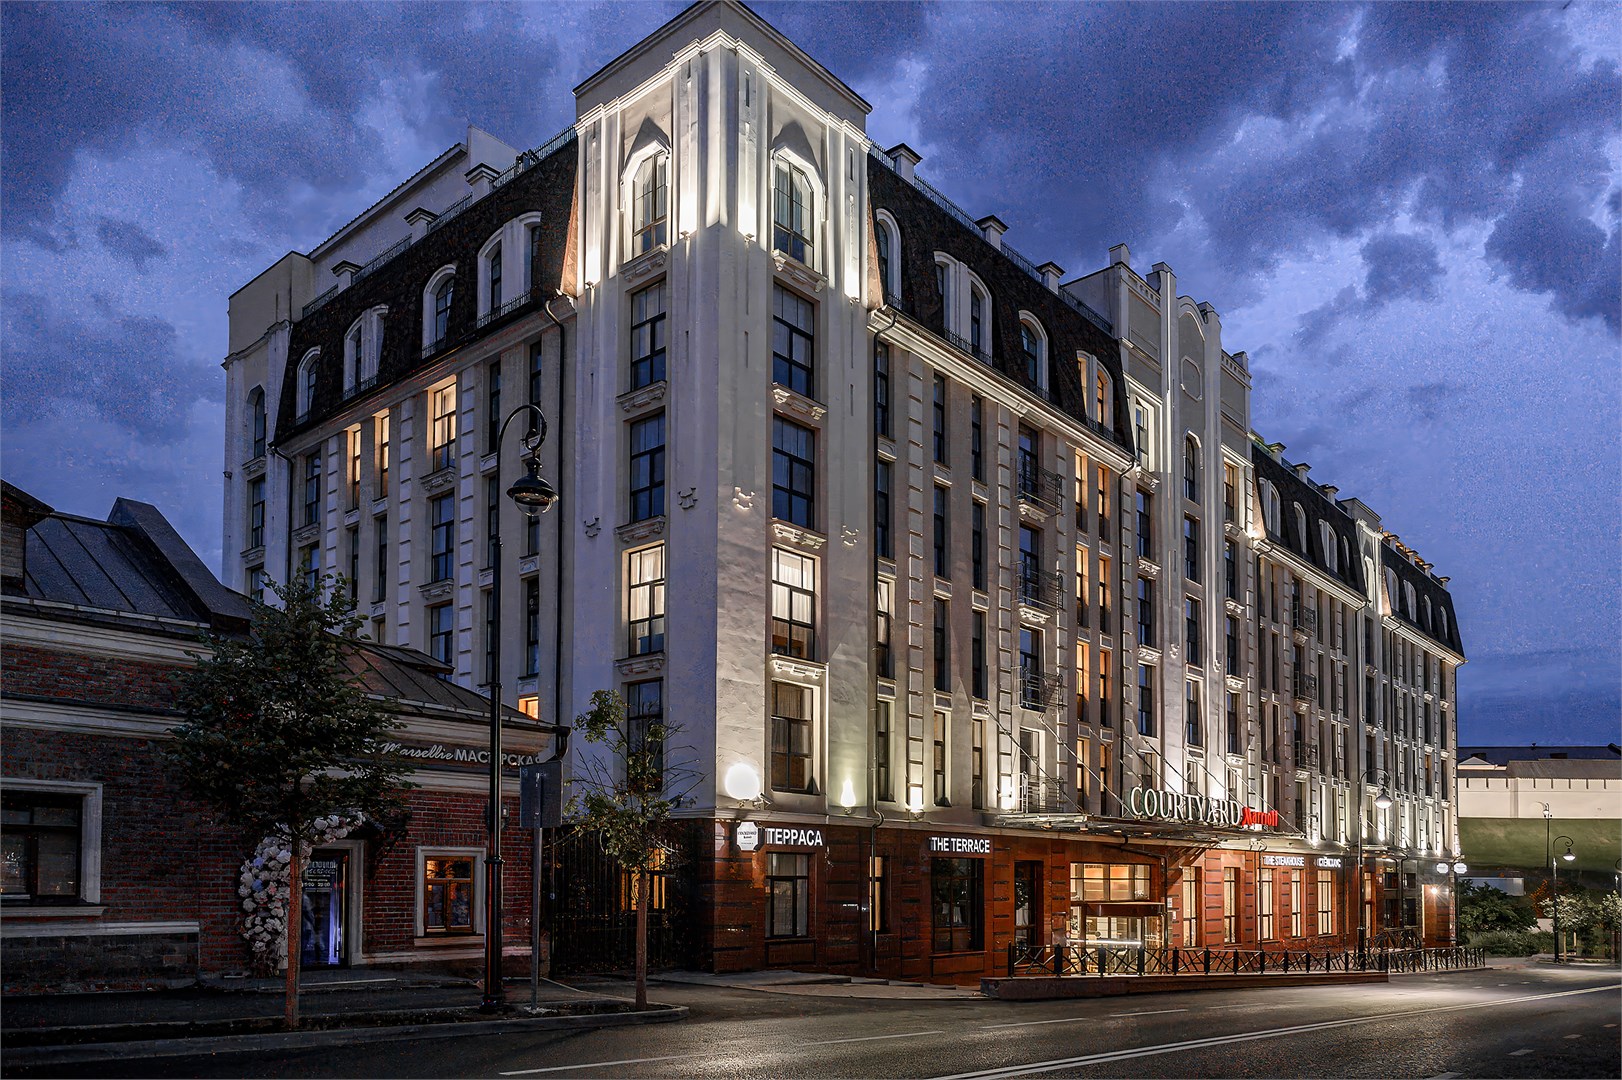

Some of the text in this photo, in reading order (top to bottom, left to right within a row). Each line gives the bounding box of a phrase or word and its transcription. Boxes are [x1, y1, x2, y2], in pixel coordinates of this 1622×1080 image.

[455, 748, 541, 766] МАСТРСКА
[1131, 785, 1241, 826] COURTYARD
[766, 828, 823, 846] ТЕРРАСА
[931, 837, 990, 853] THE TERRACE
